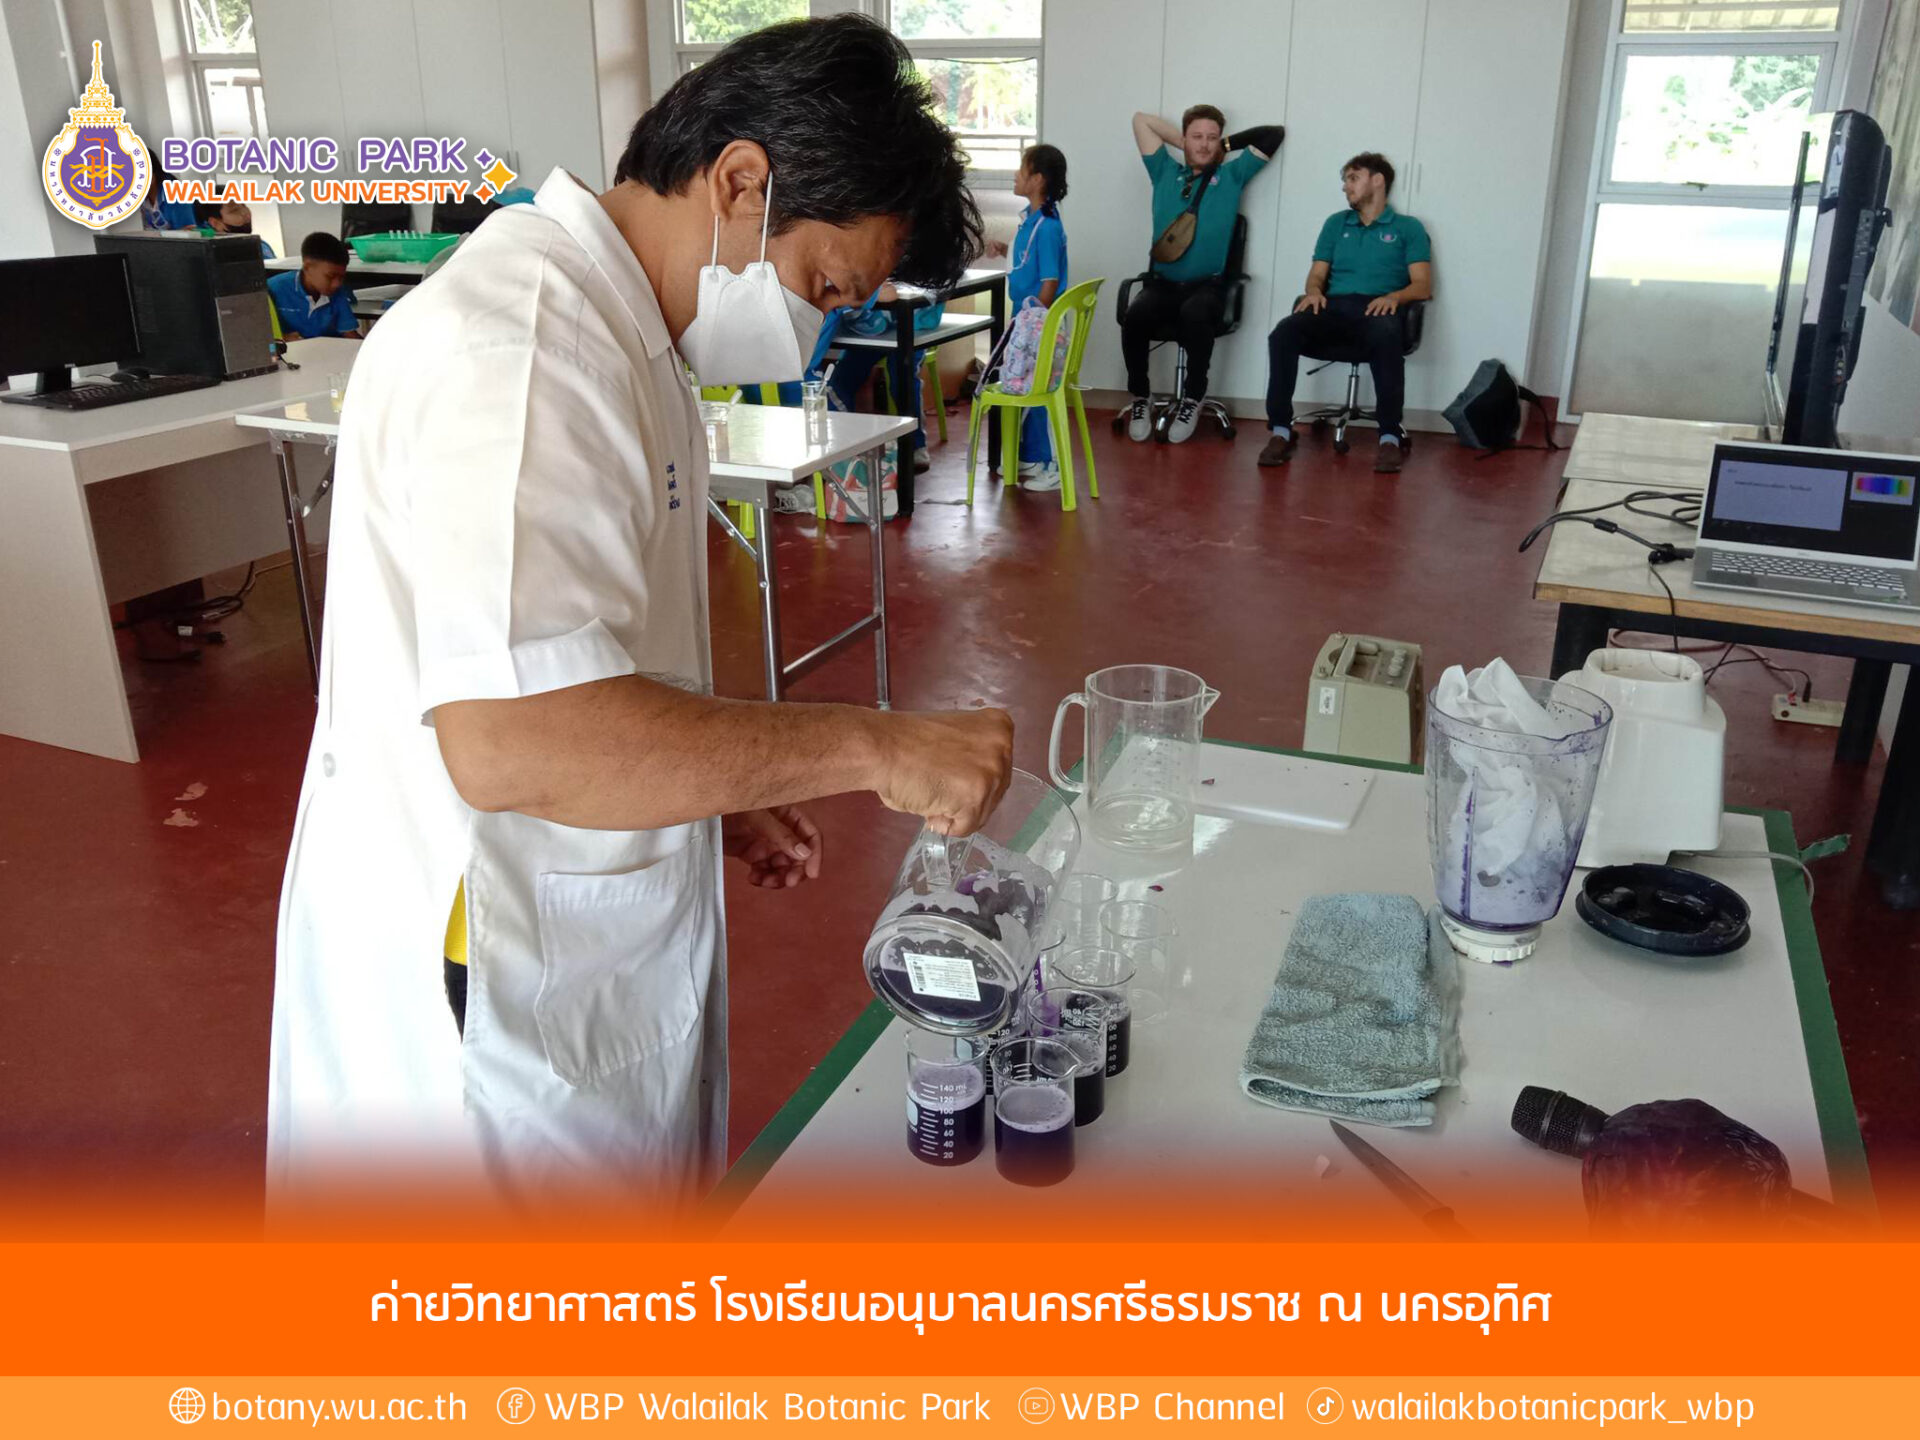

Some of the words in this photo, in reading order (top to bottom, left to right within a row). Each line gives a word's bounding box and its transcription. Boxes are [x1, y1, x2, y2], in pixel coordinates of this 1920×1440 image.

[939, 1084, 954, 1092] 140
[939, 1107, 954, 1115] 100
[943, 1118, 954, 1126] 80
[943, 1129, 954, 1137] 60
[943, 1140, 954, 1148] 40
[943, 1151, 954, 1159] 20
